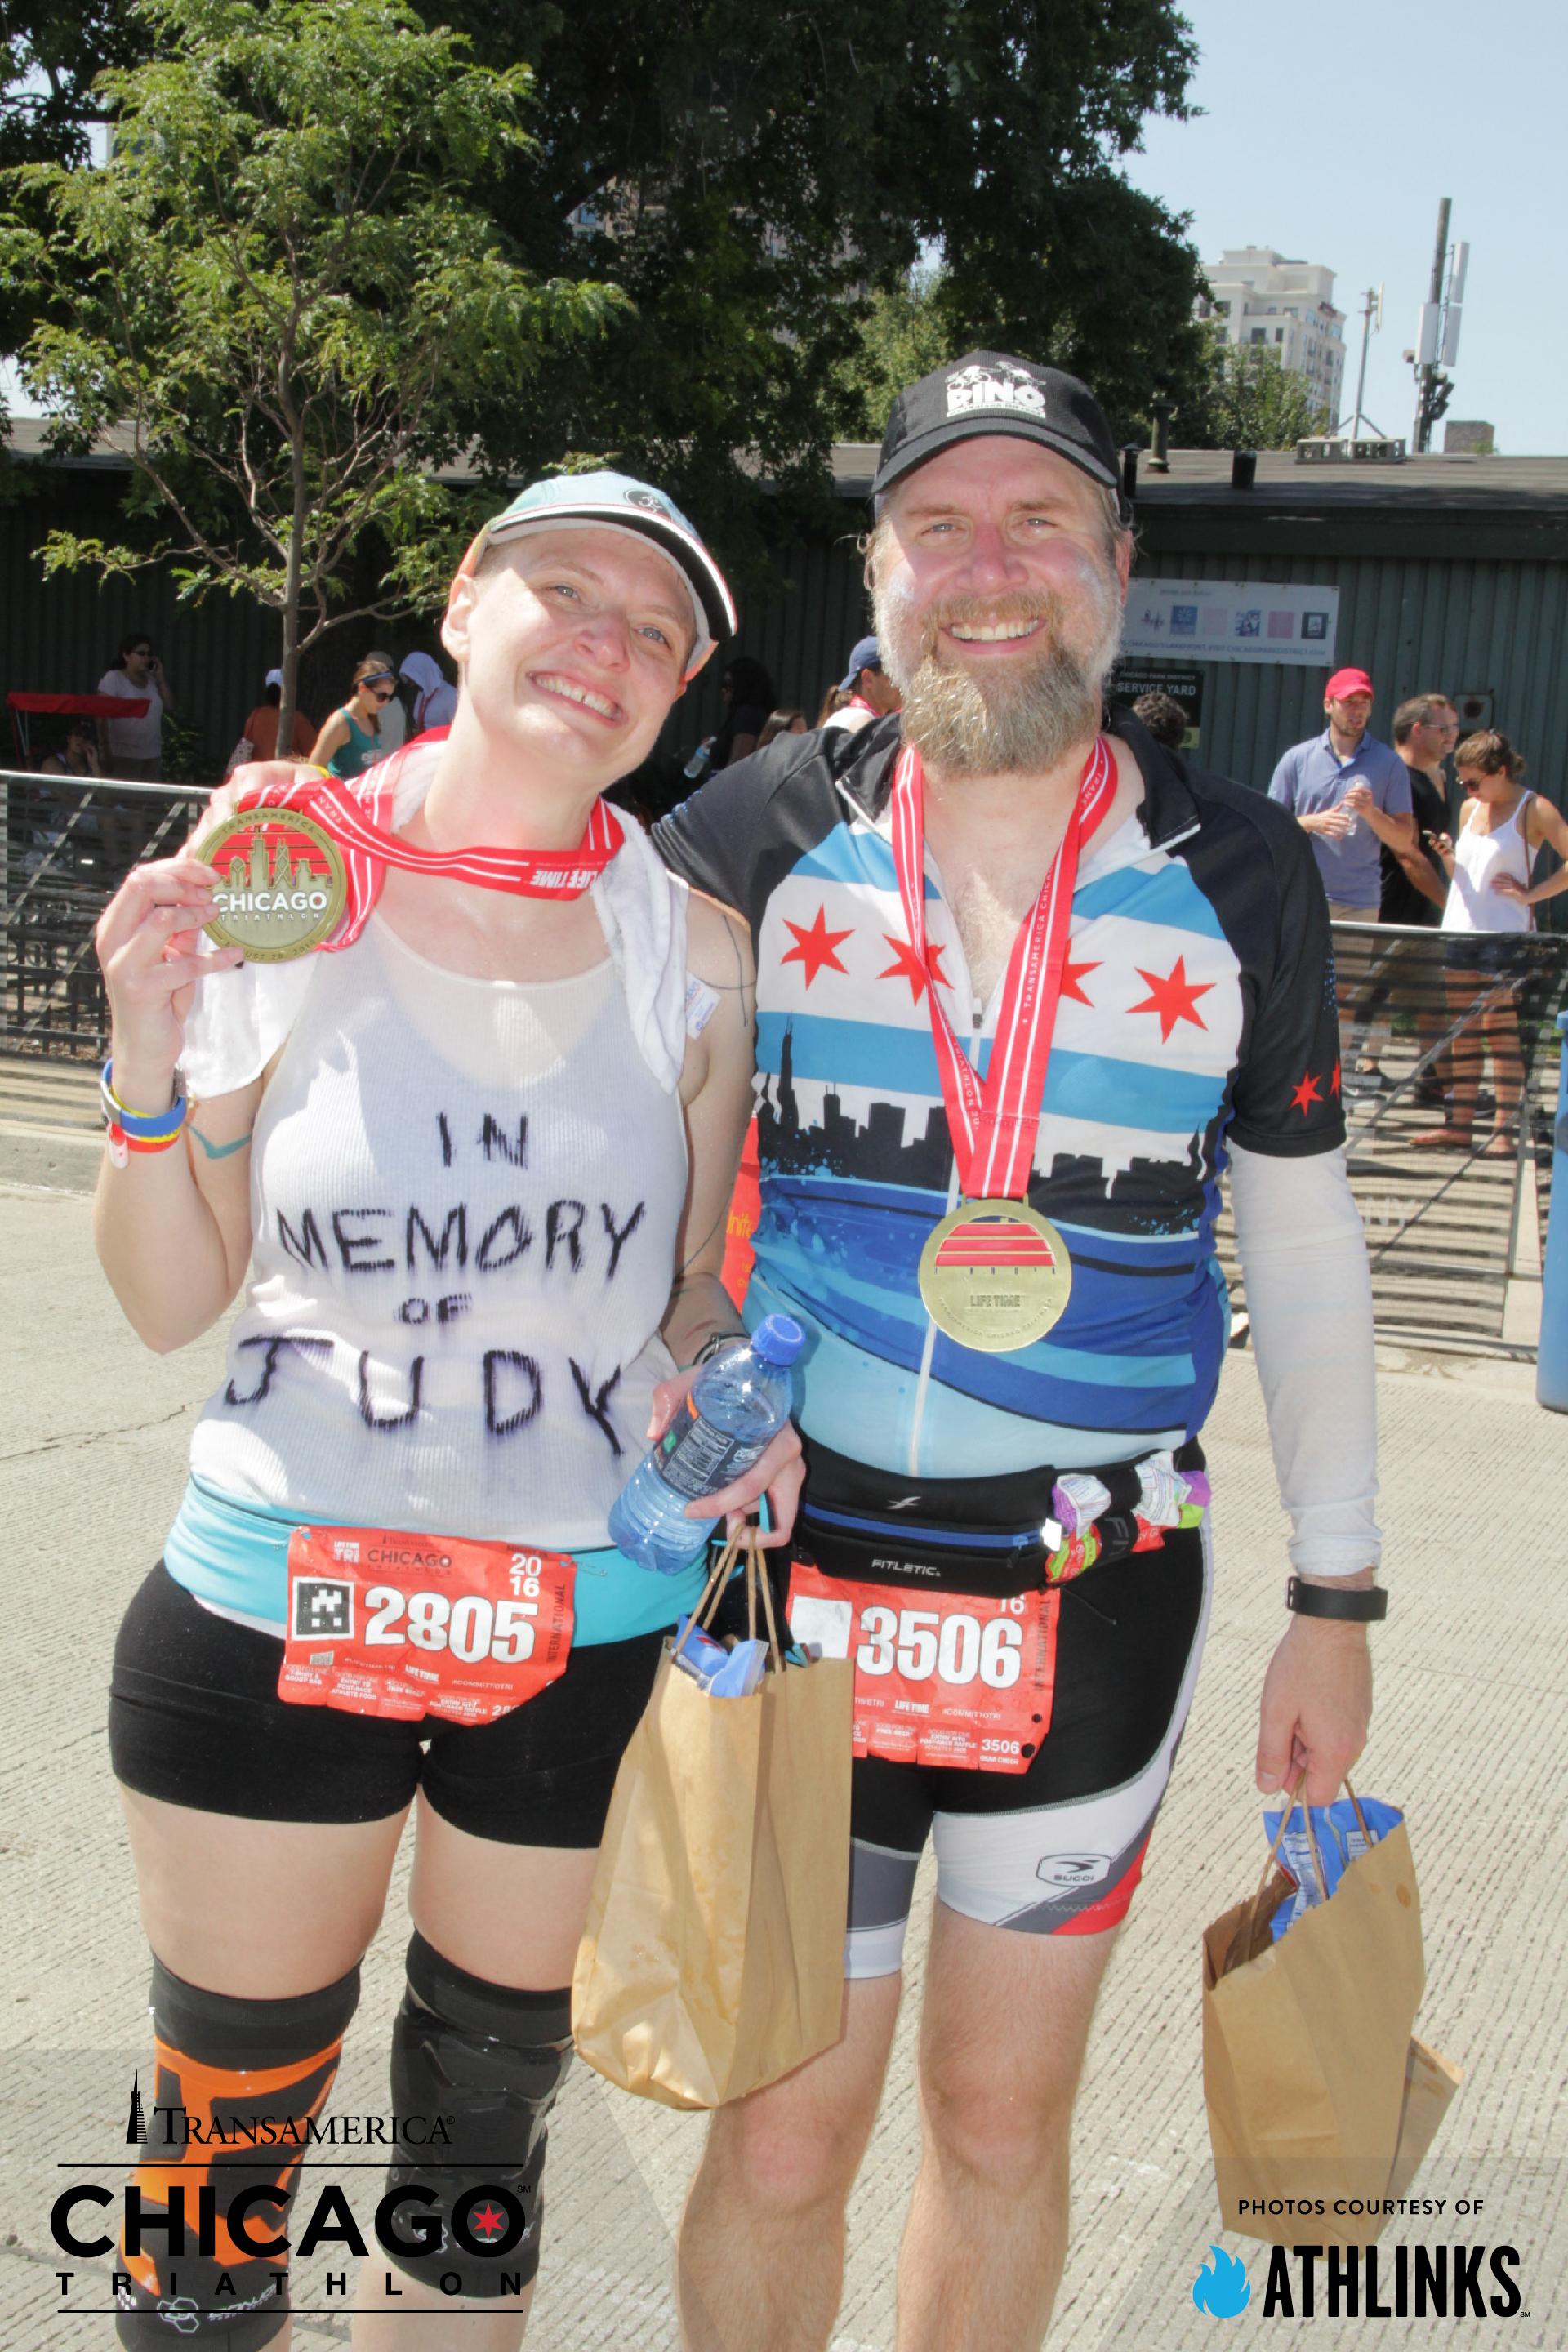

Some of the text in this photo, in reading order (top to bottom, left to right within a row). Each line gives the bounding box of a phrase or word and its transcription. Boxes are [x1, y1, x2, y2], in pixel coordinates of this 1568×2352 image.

[1117, 682, 1196, 696] SERVICE YARD
[212, 892, 327, 913] CHICAGO
[221, 913, 320, 921] TRIATHLON
[437, 1111, 528, 1169] IN
[277, 1200, 645, 1280] MEMORY
[395, 1292, 472, 1324] OF
[970, 1295, 1021, 1307] LIFE TIME
[223, 1336, 626, 1456] JUDY
[334, 1549, 359, 1564] TRI
[368, 1549, 452, 1568] CHICAGO
[509, 1553, 541, 1577] 20
[871, 1559, 940, 1577] FITLETIC
[510, 1576, 539, 1597] 16
[364, 1584, 538, 1664] 2805
[546, 1584, 566, 1664] INTERNATIONAL
[857, 1605, 1022, 1689] 3506
[452, 1679, 514, 1690] #COMMITTOTRI
[894, 1699, 930, 1714] LIFE TIME
[942, 1708, 1001, 1720] #COMMITTOTRI
[982, 1738, 1020, 1755] 3506
[980, 1754, 1019, 1766] GEAR CHECK
